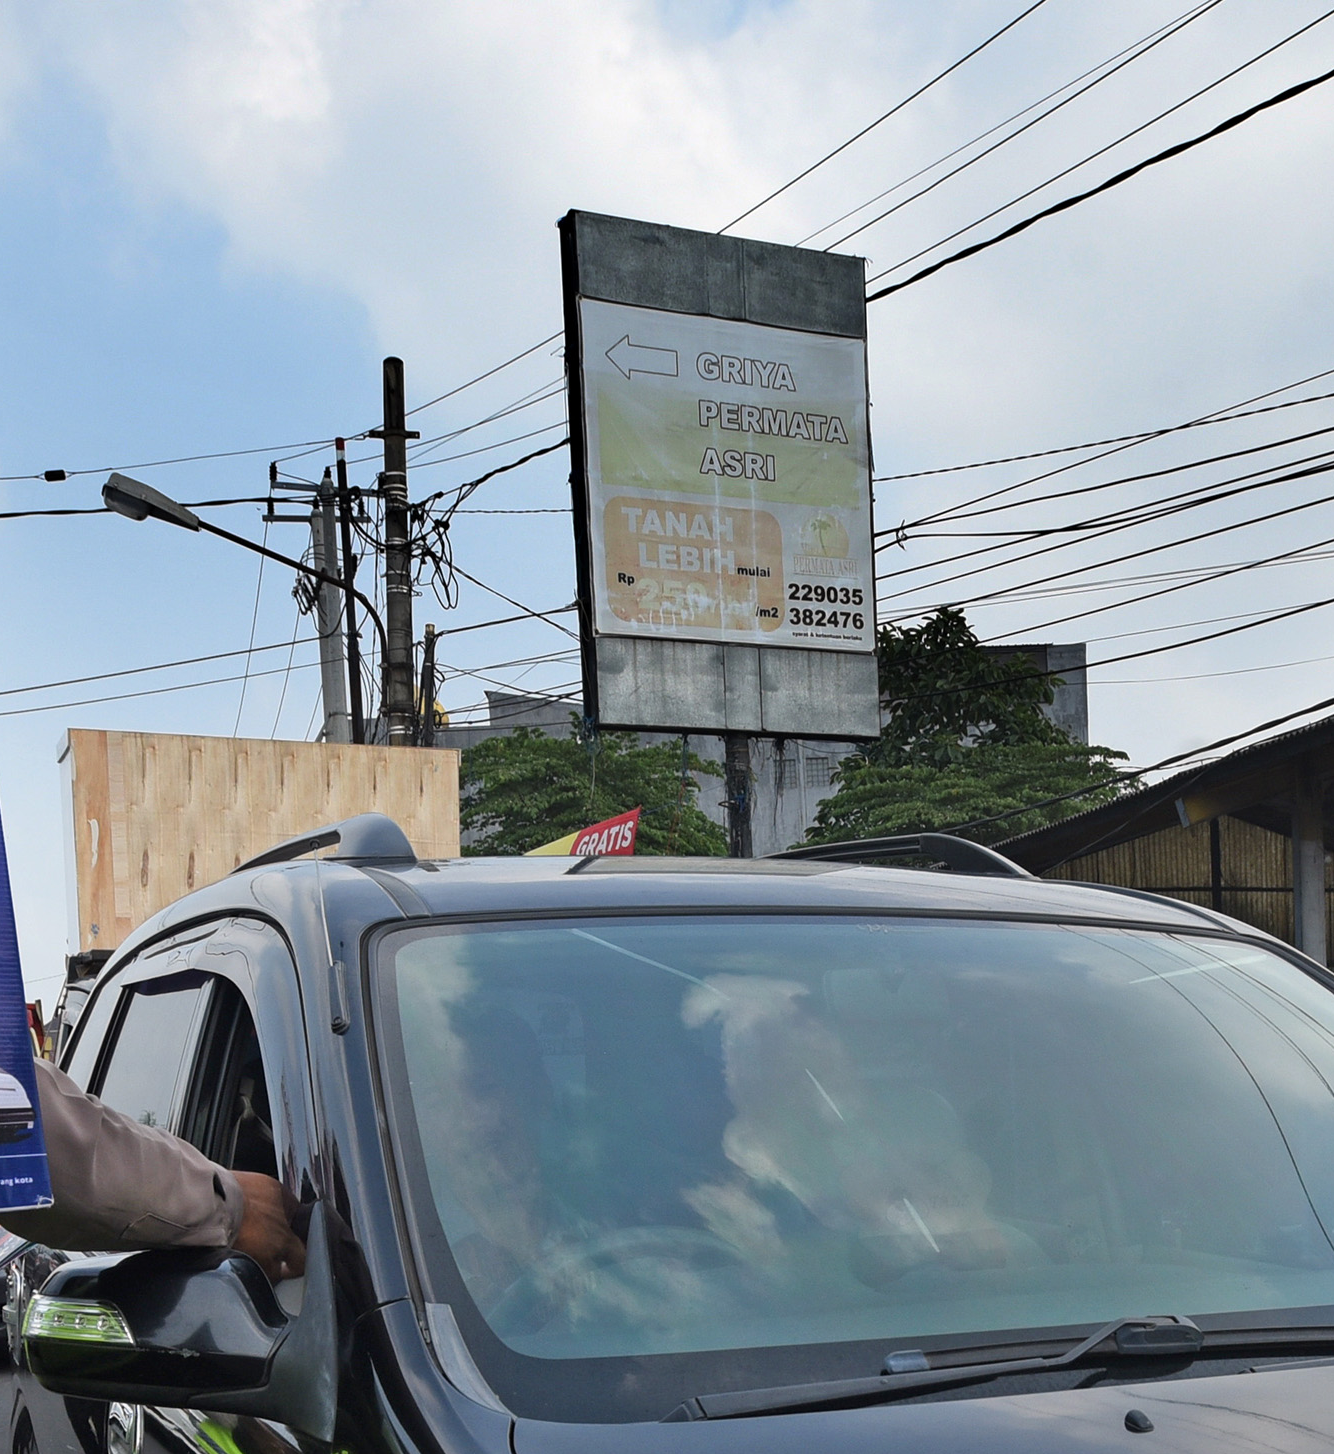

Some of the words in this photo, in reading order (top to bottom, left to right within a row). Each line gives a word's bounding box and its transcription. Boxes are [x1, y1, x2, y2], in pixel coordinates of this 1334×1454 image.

[696, 352, 797, 391] GRIYA
[698, 399, 849, 444] PERMATA
[700, 447, 776, 482] ASRI
[621, 506, 734, 542] TANAH
[638, 542, 735, 575] LEBIH
[737, 566, 771, 578] mulai
[617, 572, 635, 586] Rp
[788, 583, 863, 606] 229035
[755, 606, 779, 618] /m2
[789, 607, 864, 630] 382476
[576, 820, 634, 856] GRATIS
[15, 1176, 34, 1185] kota
